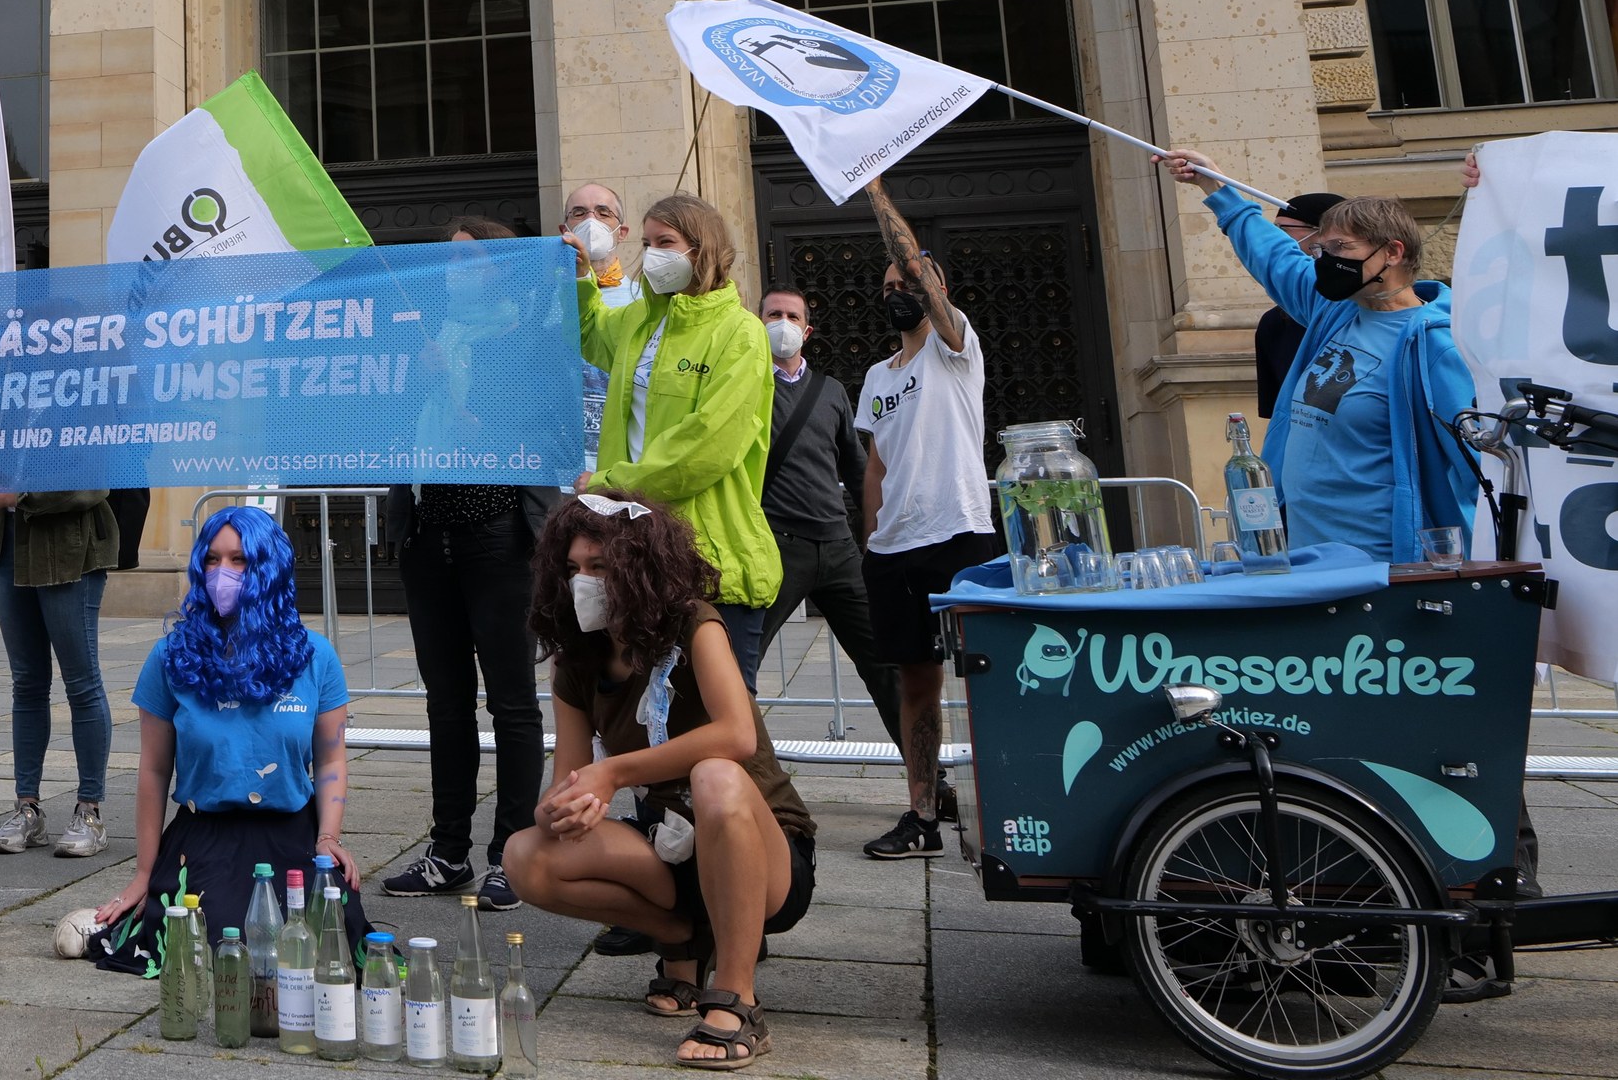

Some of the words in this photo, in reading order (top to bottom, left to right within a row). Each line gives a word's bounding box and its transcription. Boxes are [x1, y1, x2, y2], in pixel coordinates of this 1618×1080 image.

[841, 84, 972, 184] berliner-wassertisch.net
[143, 295, 374, 349] SCHÜTZEN
[153, 354, 411, 403] UMSETZEN!
[13, 427, 53, 450] UND
[59, 420, 217, 448] BRANDENBURG
[172, 443, 542, 475] www.wassernetz-initiative.de
[1088, 631, 1476, 696] Wasserkiez
[279, 704, 307, 712] NABU
[1003, 816, 1050, 838] atip
